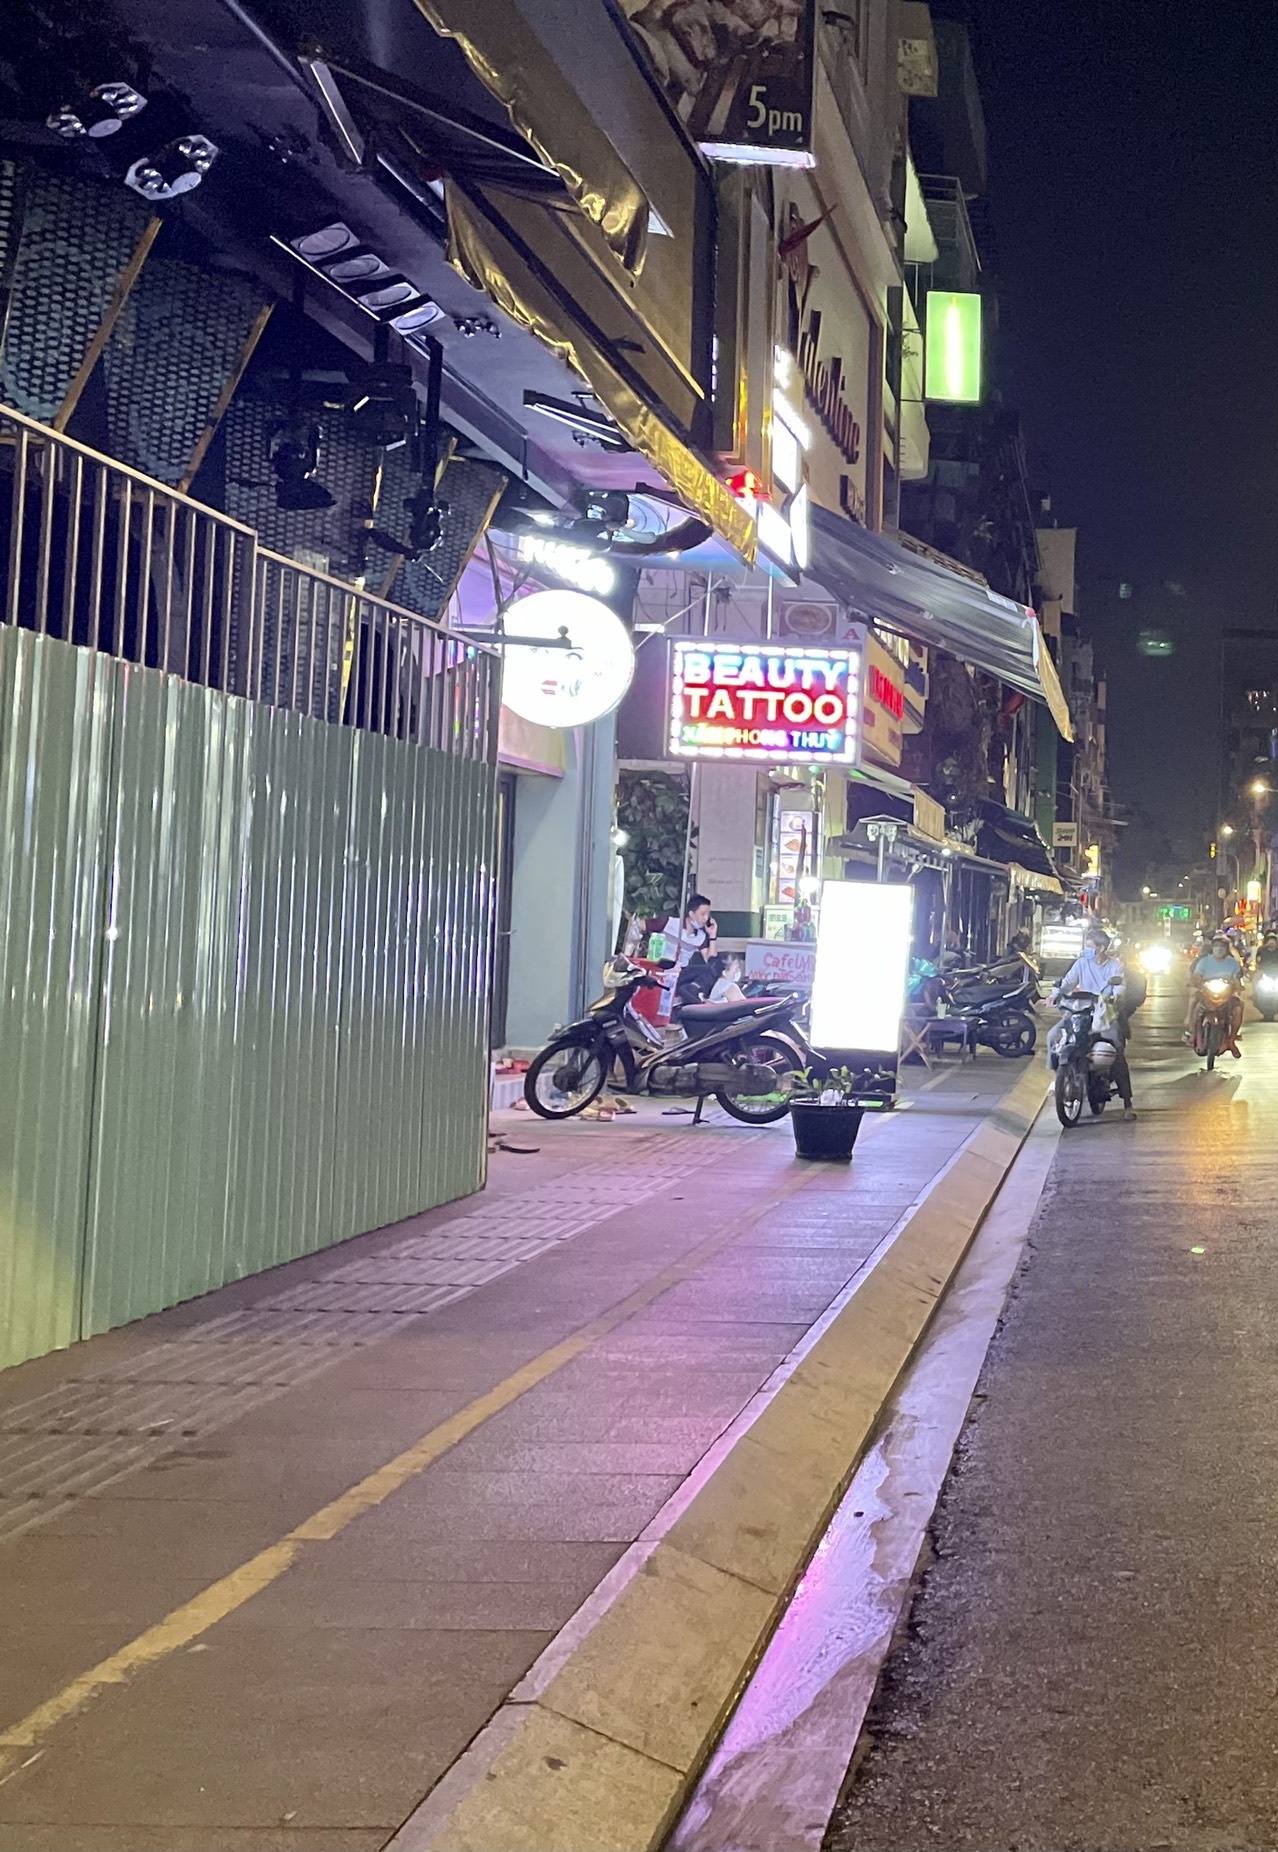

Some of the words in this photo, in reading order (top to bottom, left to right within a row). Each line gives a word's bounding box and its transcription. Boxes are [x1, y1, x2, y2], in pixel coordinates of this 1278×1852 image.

[747, 86, 802, 132] 5pm
[684, 653, 846, 690] BEAUTY
[683, 688, 843, 724] TATTOO
